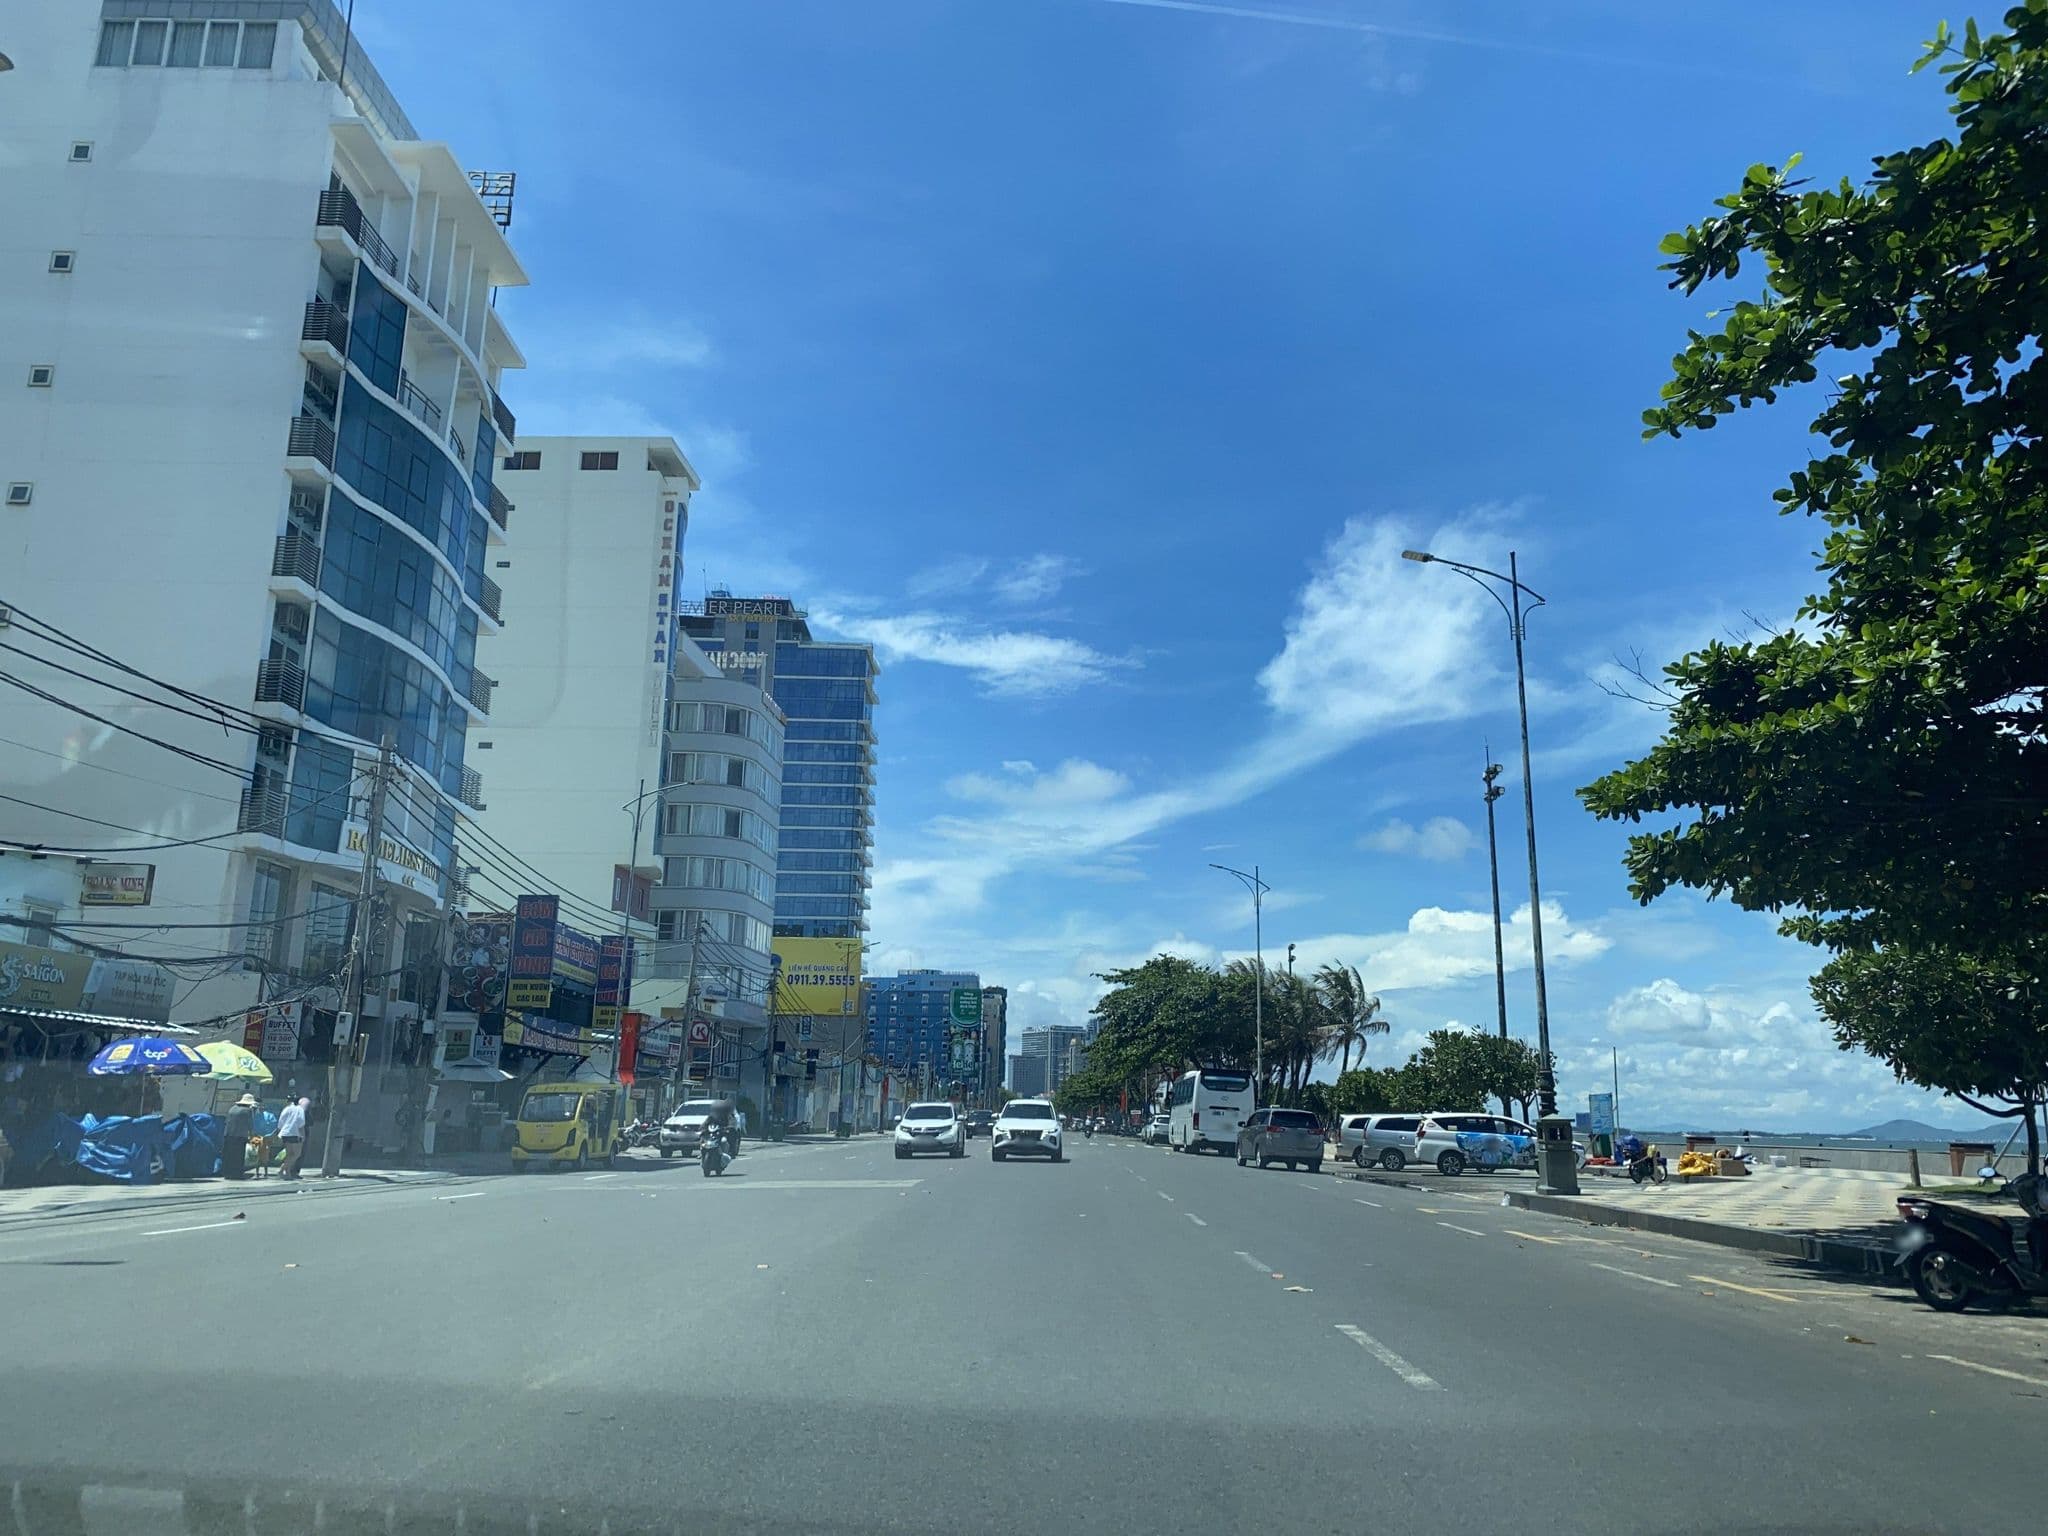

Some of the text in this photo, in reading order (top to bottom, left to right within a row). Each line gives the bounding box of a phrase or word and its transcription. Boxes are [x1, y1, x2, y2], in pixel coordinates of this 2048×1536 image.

[656, 499, 676, 588] OCEAN
[733, 602, 783, 616] PEARL
[652, 593, 669, 664] STAR
[40, 955, 55, 967] BIA
[787, 974, 855, 986] 0911.39.5555
[268, 1019, 296, 1029] BUFFET
[697, 1027, 706, 1037] K
